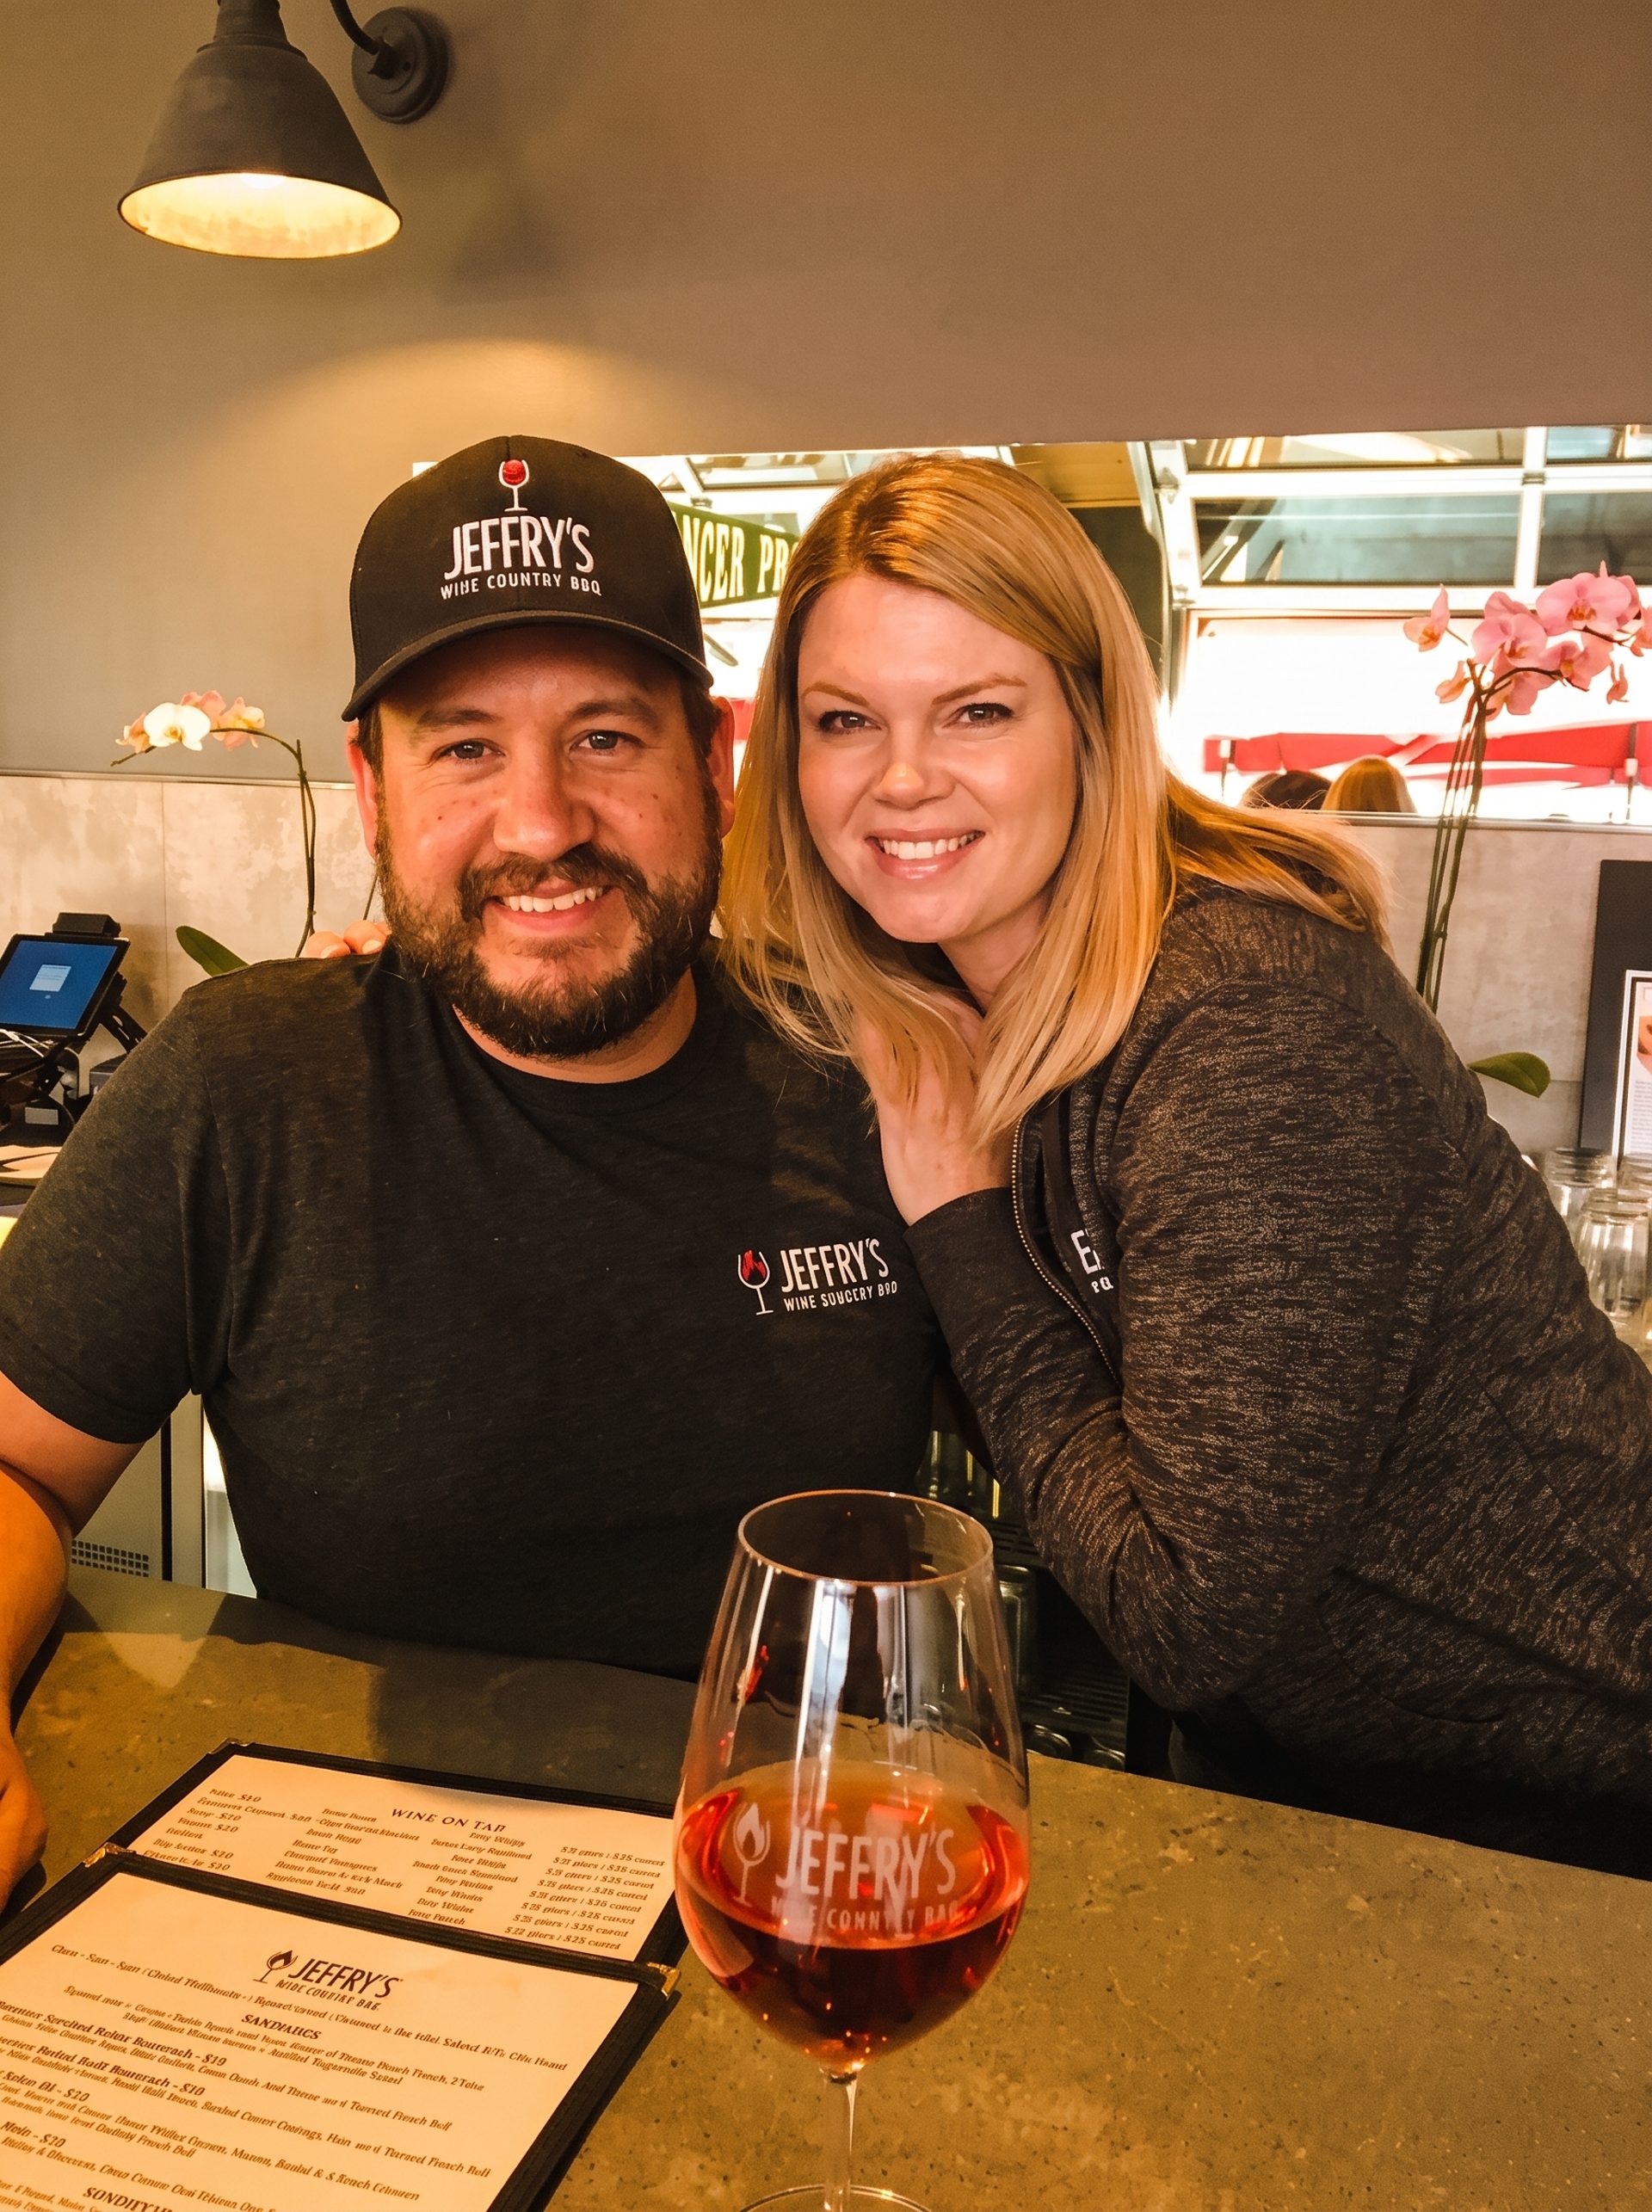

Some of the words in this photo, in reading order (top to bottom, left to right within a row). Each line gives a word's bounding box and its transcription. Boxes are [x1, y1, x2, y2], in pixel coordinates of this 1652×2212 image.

[444, 516, 595, 581] JEFFRY'S
[672, 510, 744, 602] NCER
[757, 533, 798, 594] PR
[487, 572, 561, 588] COUNTRY
[570, 576, 601, 595] BBQ
[780, 1238, 889, 1293] JEFFRY'S
[784, 1295, 817, 1312] WINE
[391, 1808, 438, 1822] WINE
[441, 1816, 468, 1827] ON
[776, 1826, 956, 1901] JEFFRY'S
[287, 1958, 400, 1999] JEFFRY'S
